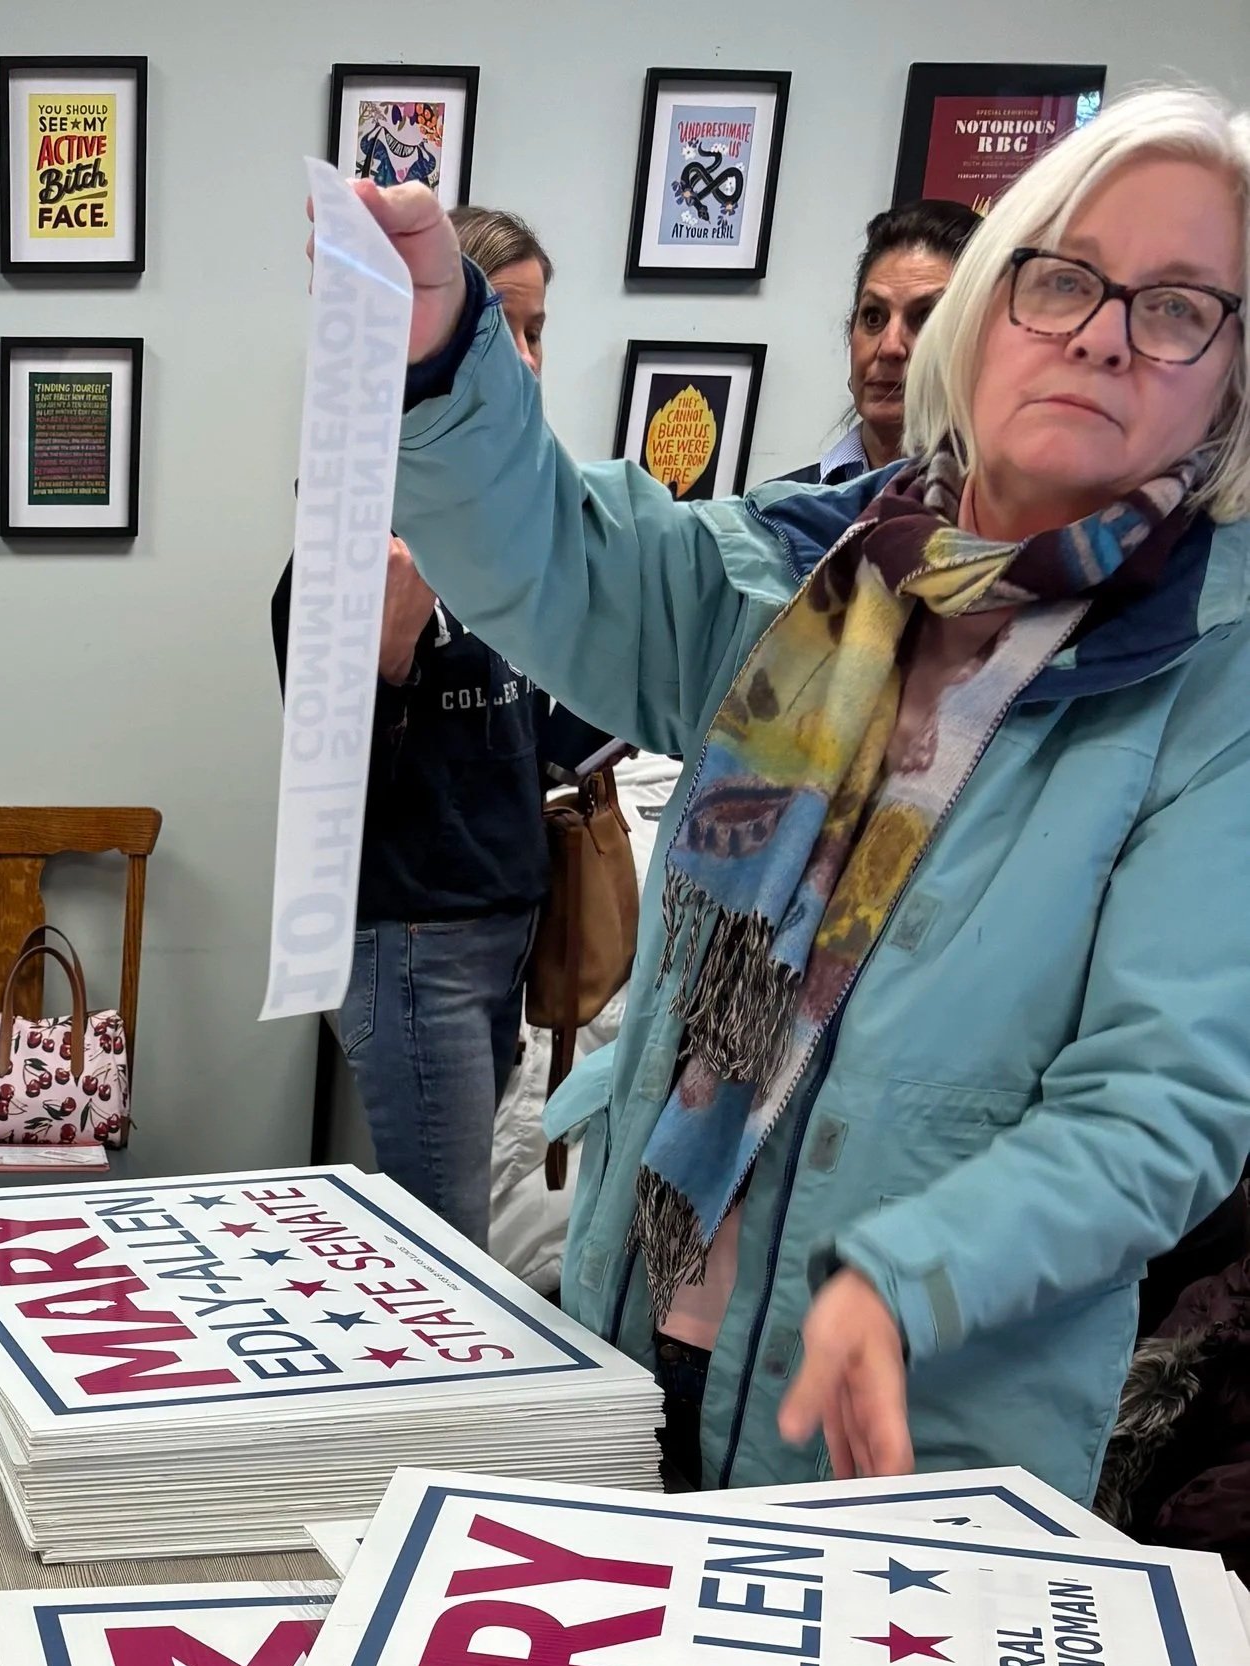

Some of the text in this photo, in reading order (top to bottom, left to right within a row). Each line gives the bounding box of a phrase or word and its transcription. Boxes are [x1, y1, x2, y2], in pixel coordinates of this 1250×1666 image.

[38, 105, 108, 115] YOU SHOULD
[39, 117, 107, 132] SEE MY
[678, 121, 752, 143] UNDERESTIMATE
[954, 120, 1056, 134] NOTORIOUS
[36, 135, 107, 171] ACTIVE
[728, 141, 741, 158] US
[977, 136, 1029, 153] RBG
[38, 158, 108, 204] Bitch
[38, 204, 109, 229] FACE.
[671, 223, 734, 239] AT YOUR PERIL
[678, 397, 700, 409] THEY
[667, 409, 703, 423] CANNOT
[658, 423, 693, 439] BURN
[652, 439, 710, 454] WE WERE
[653, 454, 706, 467] MADE FROM
[662, 467, 692, 485] FIRE
[244, 1185, 396, 1275] SENATE
[85, 1197, 343, 1379] EDLY-ALLEN
[355, 1277, 516, 1364] STATE
